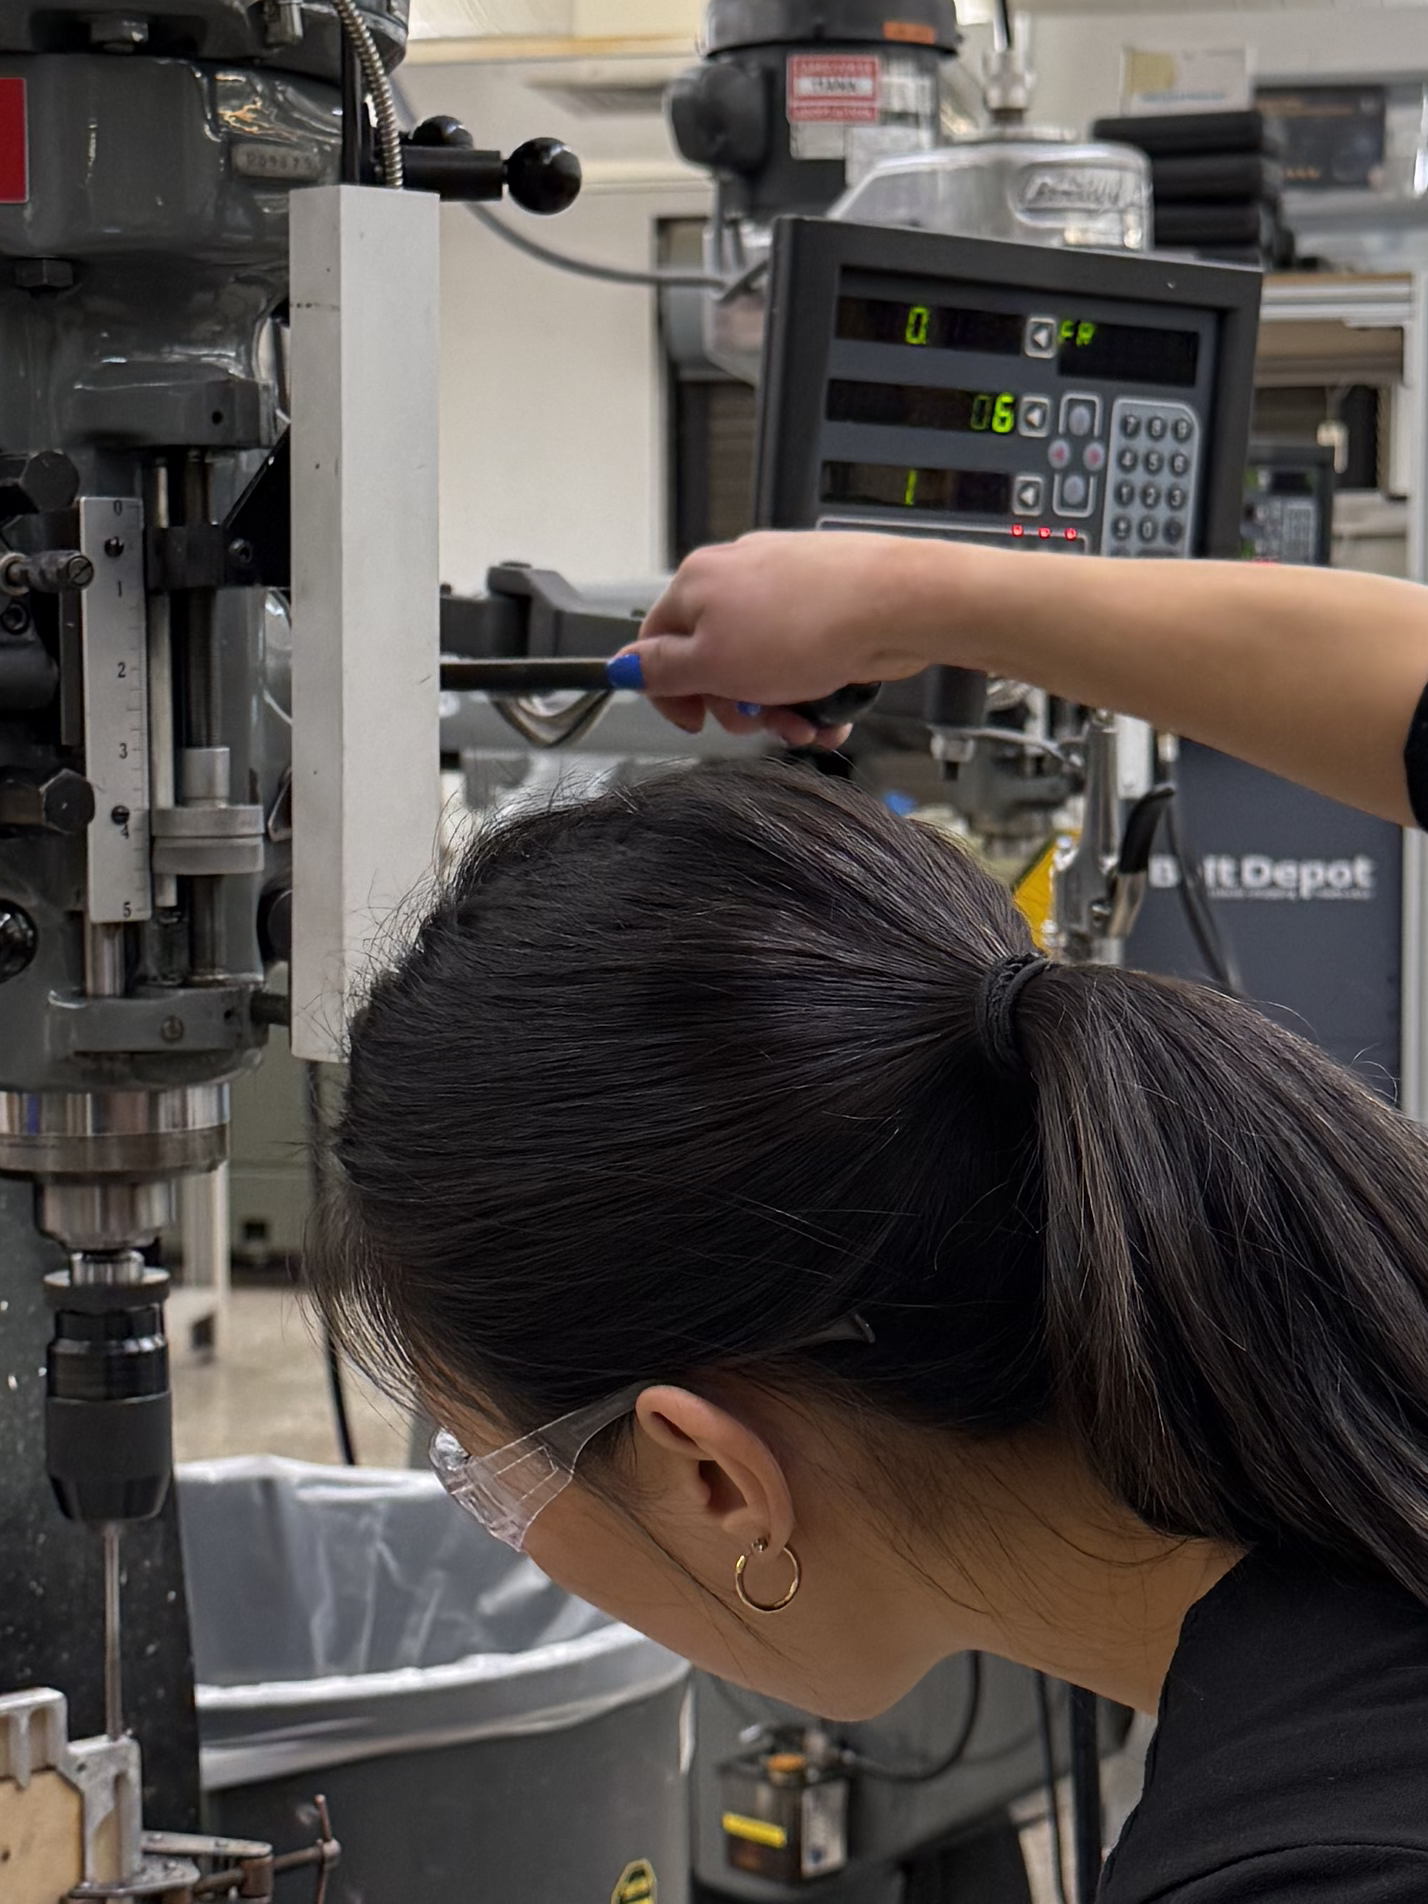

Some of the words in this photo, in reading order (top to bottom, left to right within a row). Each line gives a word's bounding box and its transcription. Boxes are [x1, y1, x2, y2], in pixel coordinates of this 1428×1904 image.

[113, 499, 123, 517] 0
[117, 580, 123, 598] 1
[117, 661, 127, 679] 2
[119, 742, 129, 760] 3
[120, 823, 131, 840] 4
[1147, 854, 1238, 889] Blt
[1240, 853, 1373, 900] Depot
[122, 901, 132, 919] 5
